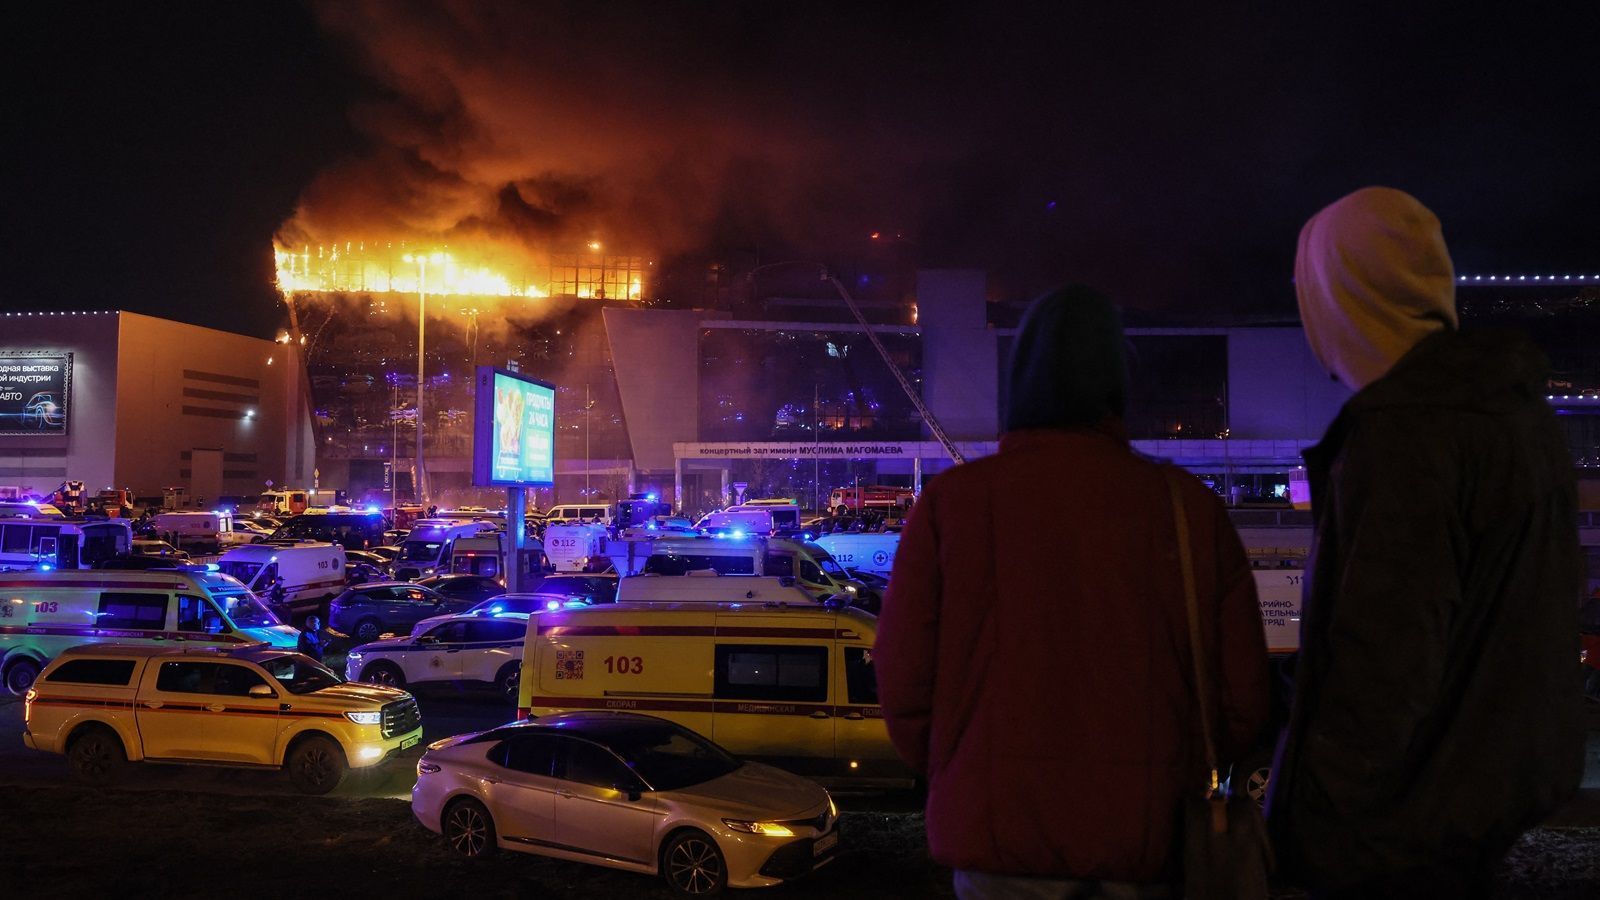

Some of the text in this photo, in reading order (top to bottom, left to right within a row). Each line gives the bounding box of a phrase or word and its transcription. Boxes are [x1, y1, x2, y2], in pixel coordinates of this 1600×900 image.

[9, 374, 51, 383] индустрии
[699, 447, 752, 456] концертный
[799, 446, 844, 455] МУСЛИМА
[846, 446, 903, 455] МАГОМАЕВА
[560, 539, 576, 547] 112
[838, 554, 854, 562] 112
[318, 560, 328, 569] 103
[34, 601, 58, 613] 103
[604, 655, 643, 674] 103
[606, 700, 637, 709] СКОРАЯ
[737, 703, 796, 713] МЕДИЦИНСКАЯ
